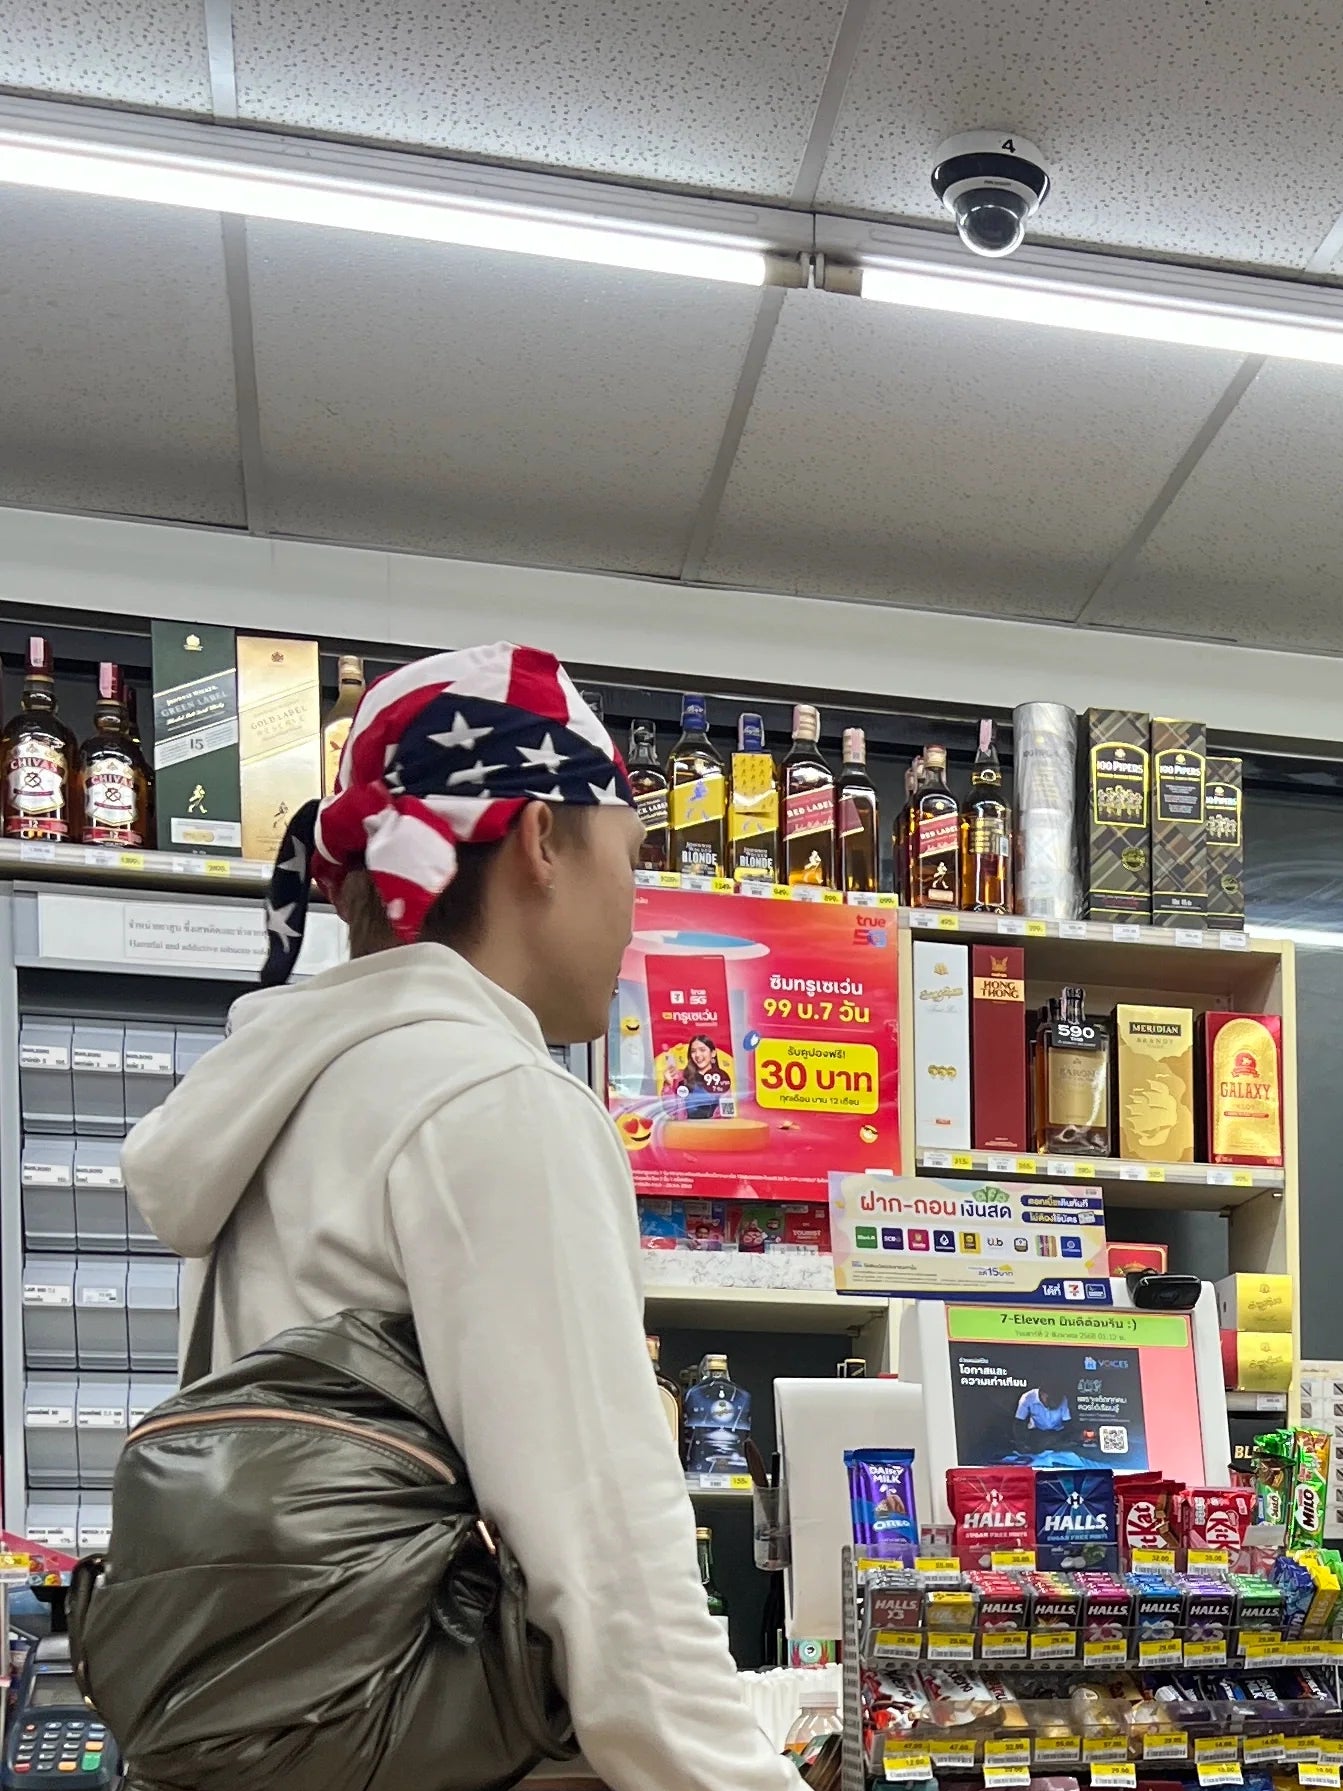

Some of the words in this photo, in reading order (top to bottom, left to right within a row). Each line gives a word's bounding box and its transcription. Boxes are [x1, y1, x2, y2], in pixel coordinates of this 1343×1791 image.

[1002, 139, 1016, 153] 4
[190, 738, 204, 751] 15
[1113, 759, 1144, 774] PIPERS
[786, 806, 806, 819] RED
[807, 800, 834, 814] LABEL
[682, 850, 718, 866] BLONDE
[740, 856, 773, 870] BLONDE
[856, 914, 886, 928] true
[769, 975, 863, 997] ซิมทรูเซเว่น
[983, 980, 1015, 991] HONG
[980, 988, 1020, 999] THONG
[764, 1000, 792, 1018] 99
[839, 1000, 870, 1023] วัน
[1058, 1025, 1095, 1039] 590
[1132, 1023, 1179, 1035] MERIDIAN
[761, 1059, 808, 1092] 30
[816, 1070, 873, 1093] บาท
[1220, 1081, 1271, 1100] GALAXY
[860, 1191, 957, 1217] ฝาก-ถอน
[960, 1200, 1012, 1219] เงินสด
[1001, 1314, 1055, 1326] 7-Eleven
[1059, 1315, 1123, 1329] ยินดีต้อนรับ
[959, 1364, 1007, 1376] โอกาสและ
[868, 1466, 904, 1477] DAIRY
[873, 1474, 901, 1484] MILK
[1302, 1490, 1316, 1529] MILO
[873, 1519, 910, 1531] OREO
[963, 1511, 1028, 1529] HALLS
[1044, 1513, 1108, 1531] HALLS
[874, 1600, 918, 1611] HALLS
[982, 1603, 1023, 1614] HALLS
[1035, 1604, 1076, 1615] HALLS
[1088, 1605, 1128, 1615] HALLS
[1140, 1603, 1180, 1613] HALLS
[1190, 1605, 1232, 1615] HALLS
[1241, 1607, 1279, 1617] HALLS
